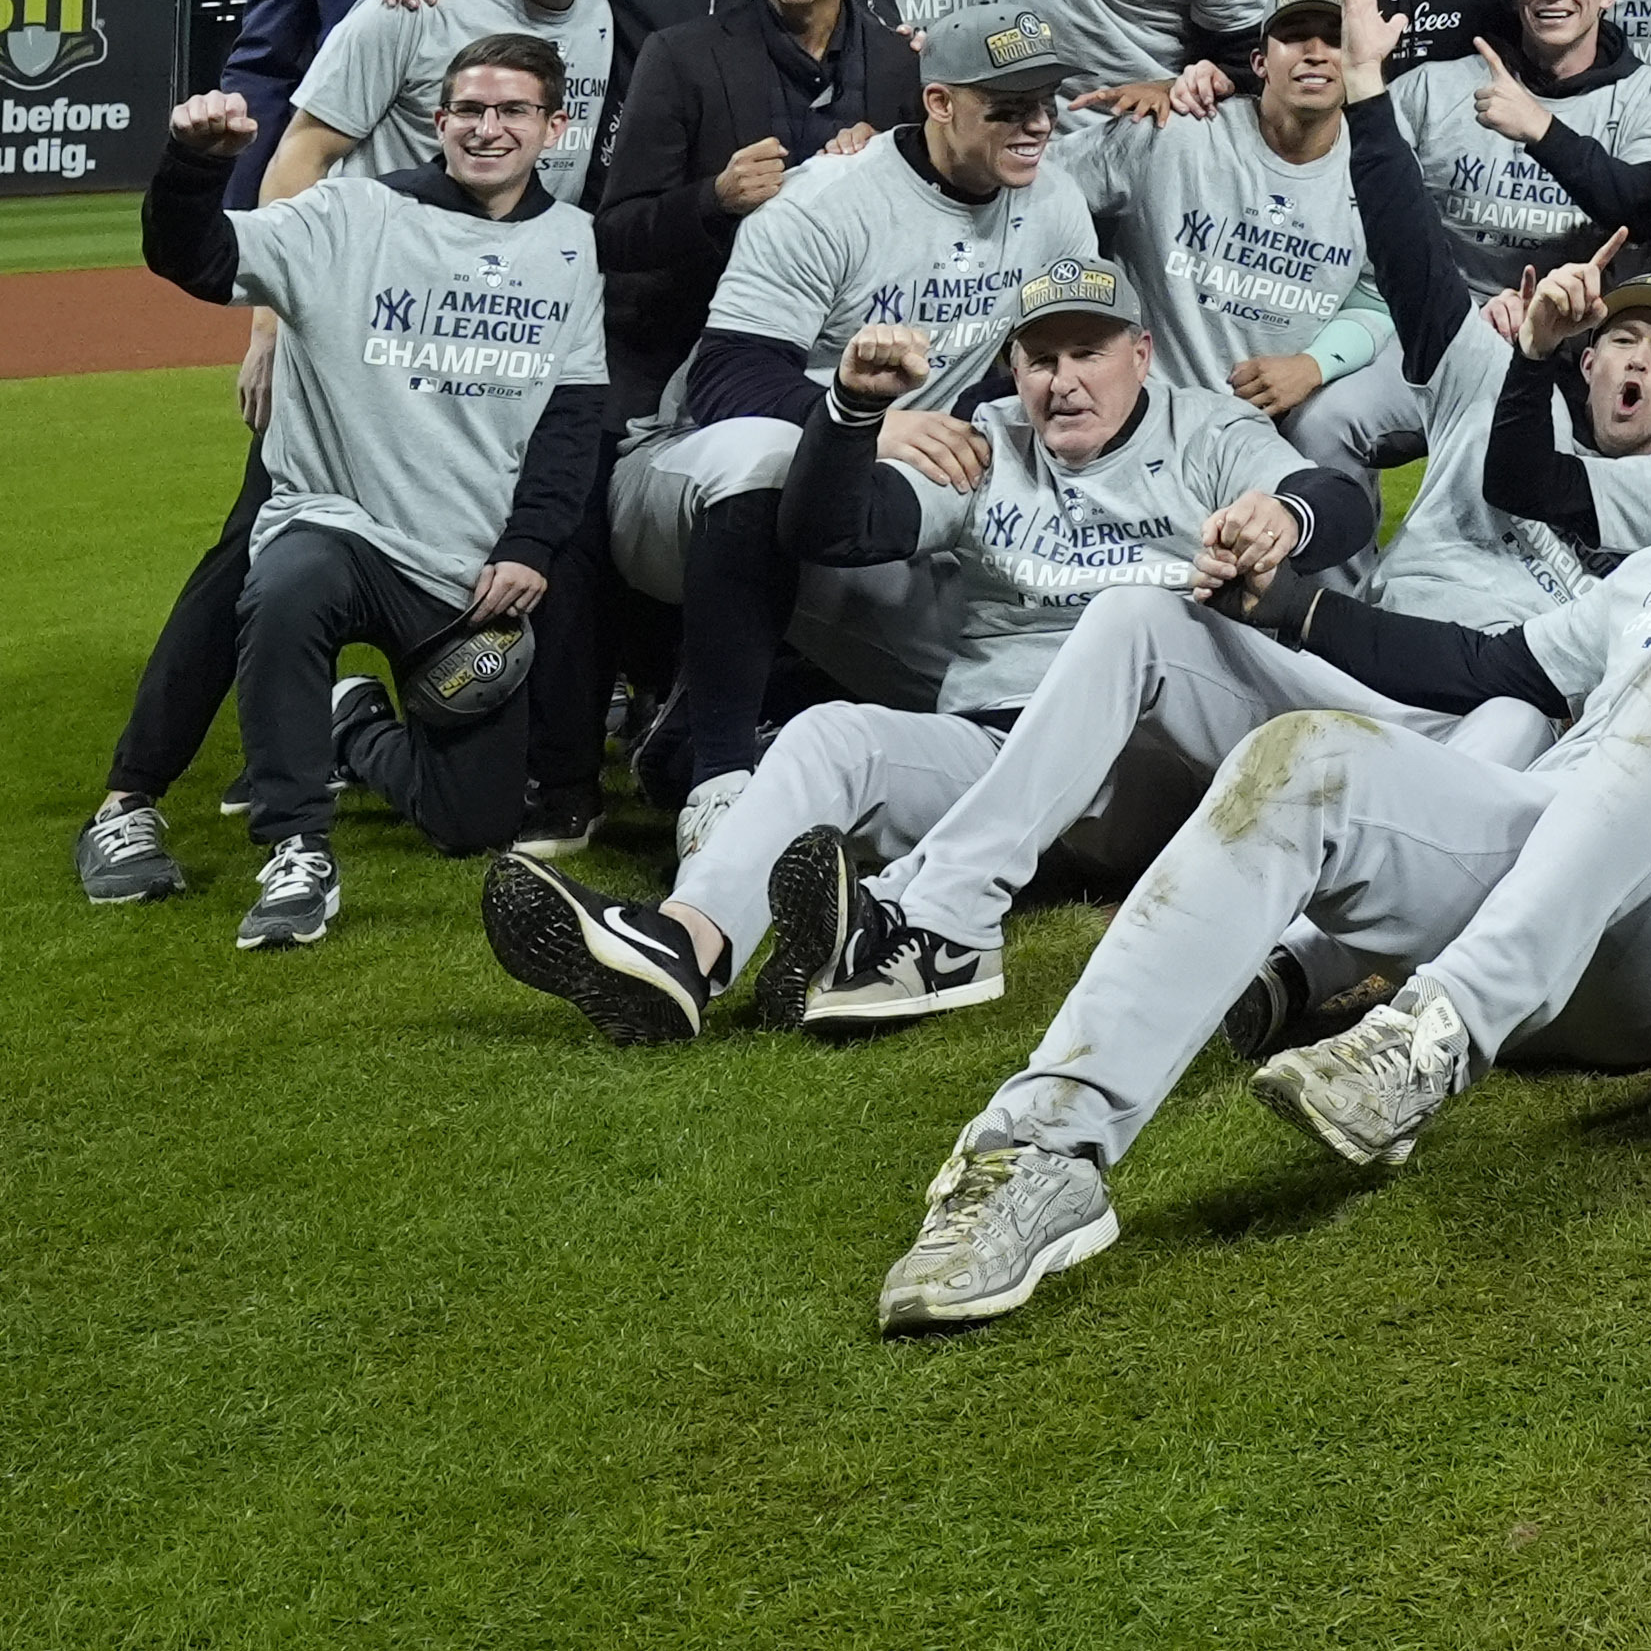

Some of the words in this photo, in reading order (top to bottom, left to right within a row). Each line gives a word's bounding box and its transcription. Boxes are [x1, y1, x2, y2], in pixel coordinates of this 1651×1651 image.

[2, 97, 130, 133] before
[23, 138, 96, 178] dig.
[1495, 180, 1577, 206] LEAGU
[1446, 195, 1592, 234] CHAMPION
[1230, 220, 1352, 267] AMERICAN
[1222, 242, 1316, 283] LEAGUE
[1023, 288, 1060, 313] WORLD
[1069, 278, 1115, 302] SERIES
[1165, 250, 1339, 317] CHAMPIONS
[433, 316, 545, 345] LEAGUE
[1221, 301, 1261, 322] ALCS
[1262, 313, 1290, 327] 2024
[439, 381, 486, 397] ALCS
[487, 387, 522, 397] 2024
[982, 553, 1191, 587] CHAMPIONS
[1032, 542, 1145, 568] LEAGUE
